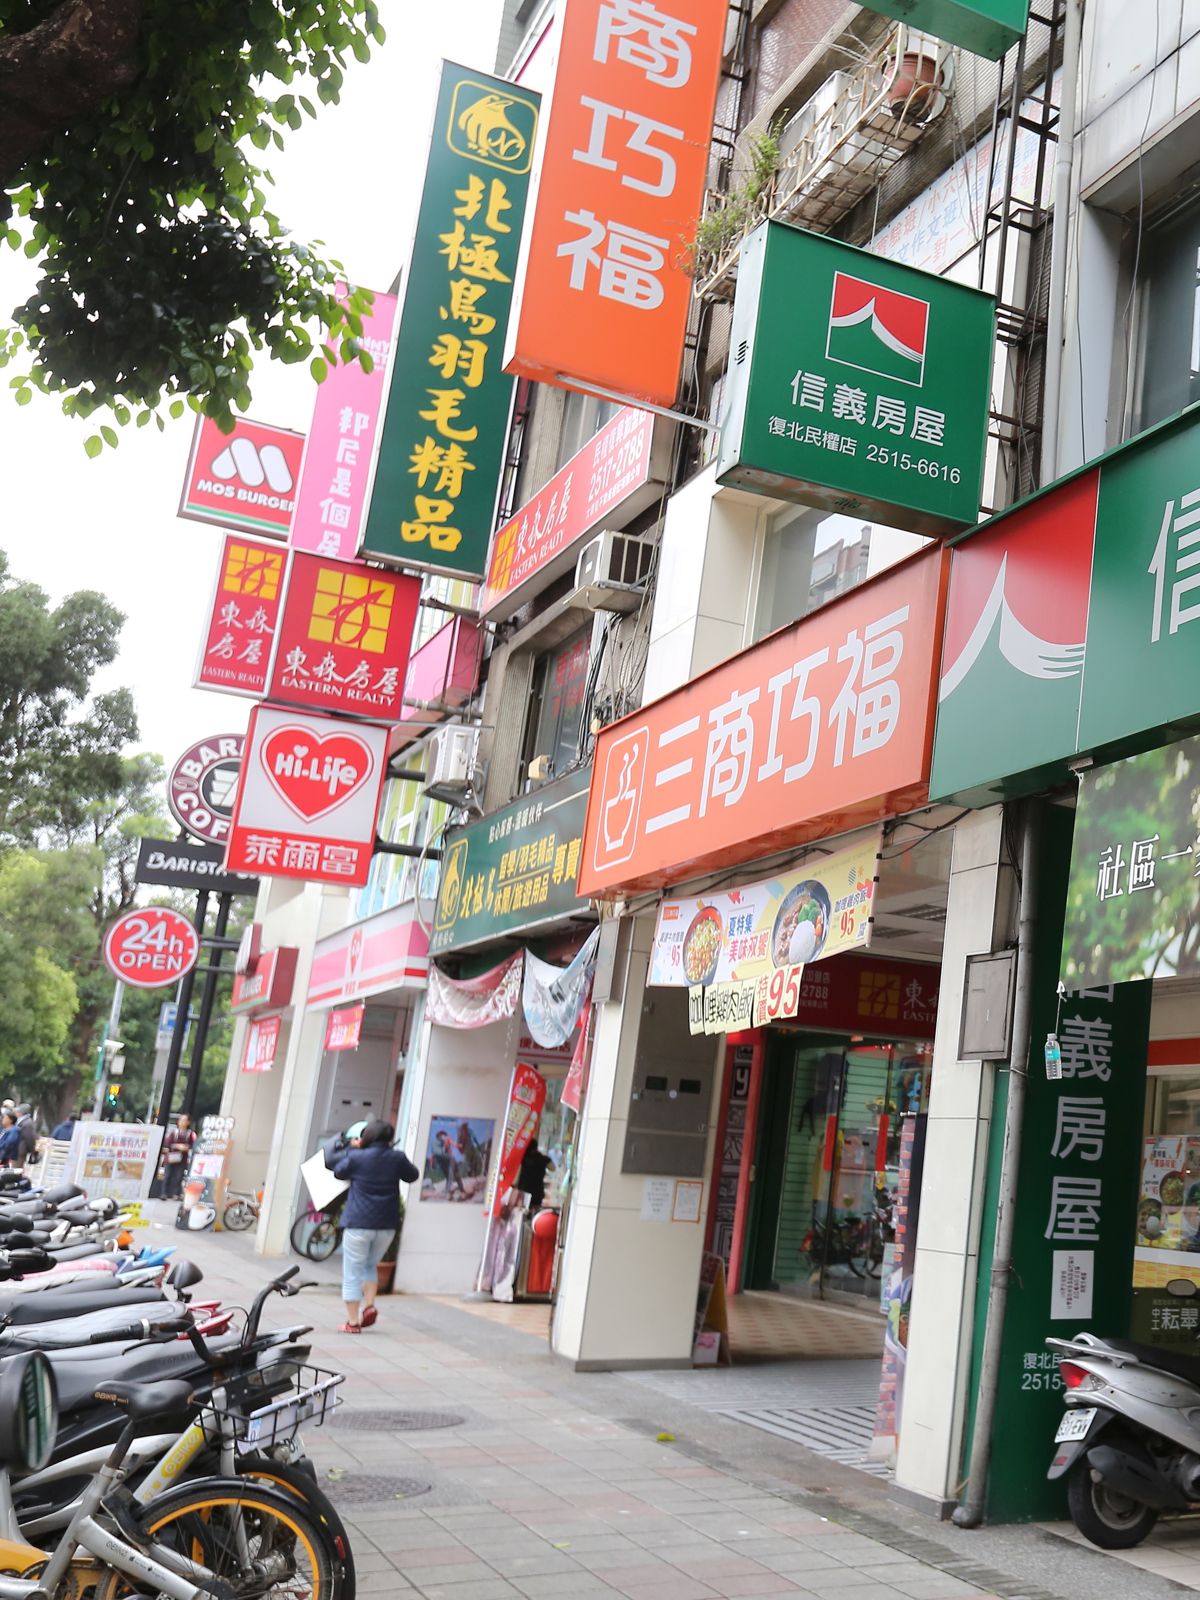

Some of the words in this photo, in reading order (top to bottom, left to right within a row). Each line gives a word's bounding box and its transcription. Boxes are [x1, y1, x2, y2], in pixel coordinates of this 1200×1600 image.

[556, 0, 698, 311] 商巧福
[399, 172, 513, 553] 北極鳥羽毛精品
[790, 369, 946, 447] 信義房屋
[768, 415, 858, 457] 復北民權店
[588, 427, 645, 503] 2517-2788
[866, 443, 961, 485] 2515-6616
[197, 479, 236, 500] MOS
[509, 553, 539, 586] EASTERN
[539, 528, 564, 562] REALTY
[217, 600, 275, 635] 東森
[208, 632, 264, 666] 房屋
[203, 665, 237, 682] EASTERN
[237, 671, 266, 686] REALTY
[281, 676, 343, 698] EASTERN
[346, 685, 396, 707] REALTY
[282, 645, 400, 696] 東森房屋
[644, 604, 910, 835] 三商巧福
[274, 745, 359, 796] Hi-Life
[243, 834, 360, 876] 萊爾富
[121, 918, 185, 954] 24h
[840, 909, 856, 938] 95
[118, 951, 184, 972] OPEN
[670, 943, 681, 967] 95
[755, 976, 769, 1023] 特價
[767, 967, 801, 1018] 95
[202, 1116, 235, 1131] MOS
[1044, 984, 1115, 1242] 義房屋
